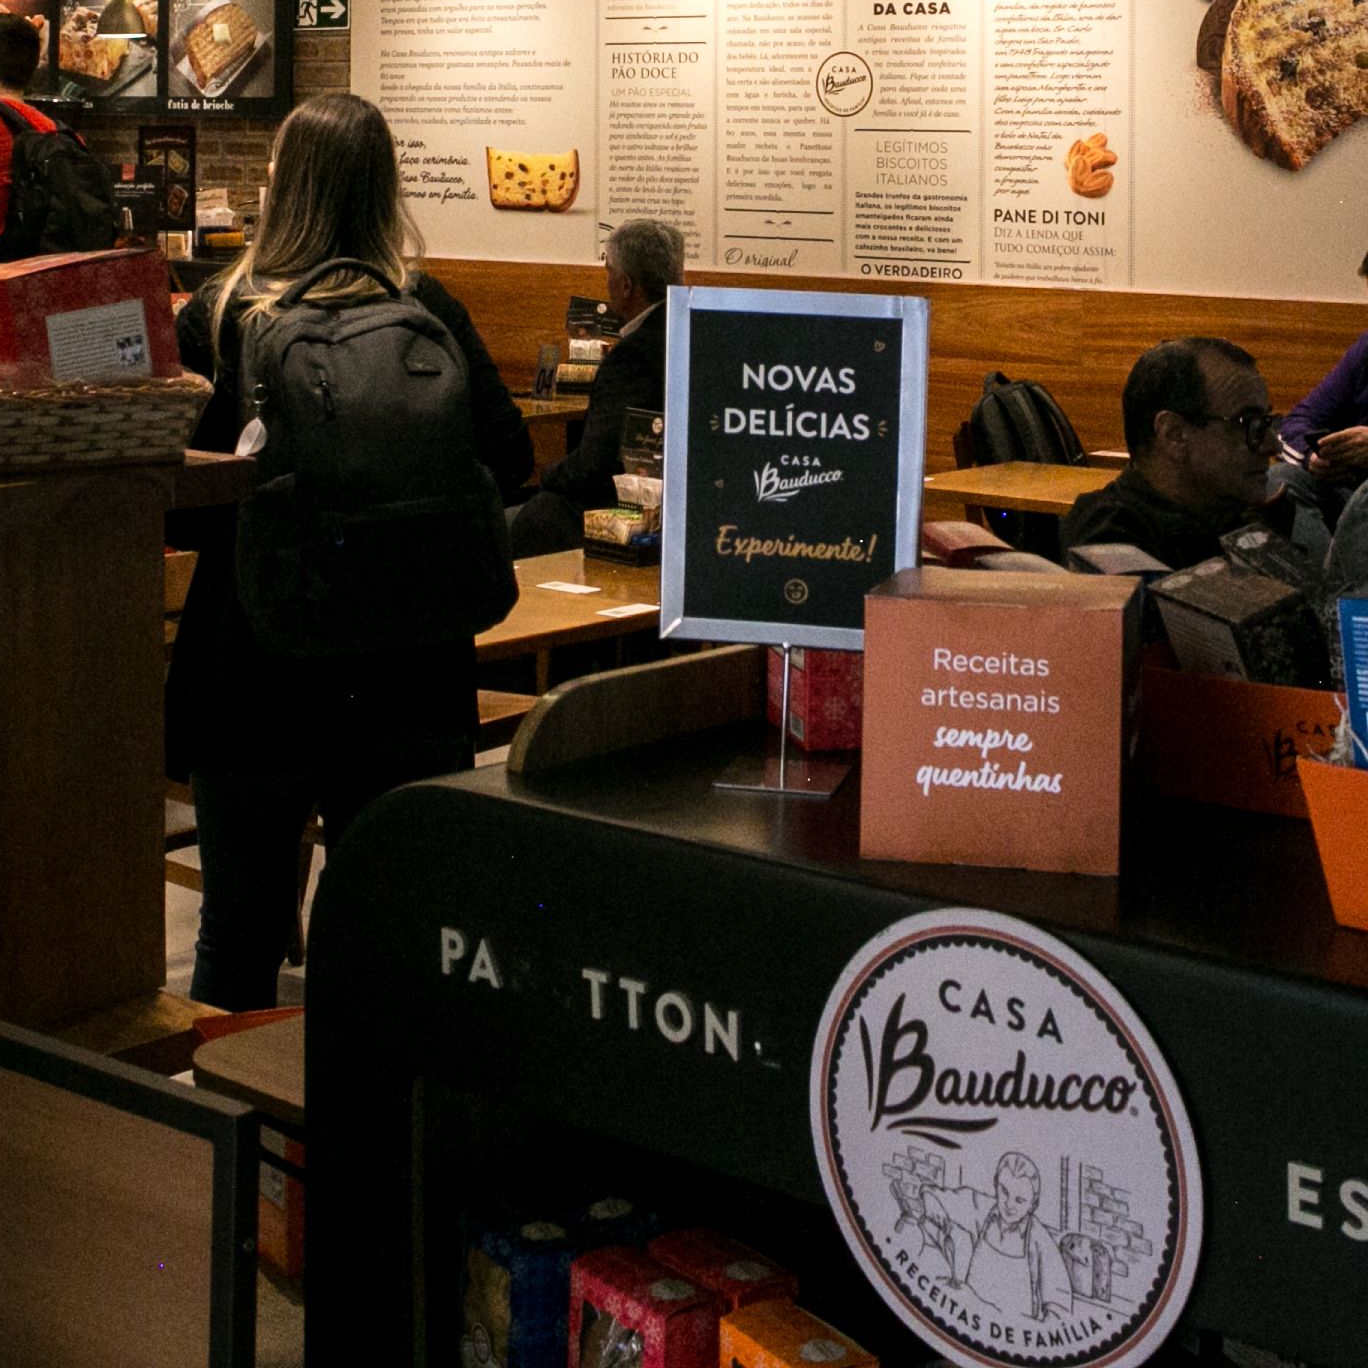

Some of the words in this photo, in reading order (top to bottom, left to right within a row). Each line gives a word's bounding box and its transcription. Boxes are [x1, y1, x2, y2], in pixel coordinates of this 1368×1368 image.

[873, 3, 897, 15] DA
[903, 2, 951, 15] CASA
[611, 49, 674, 64] HISTÓRIA
[678, 52, 699, 64] DO
[612, 65, 636, 79] PÃO
[641, 67, 677, 79] DOCE
[612, 88, 626, 97] UM
[628, 86, 647, 97] PÃO
[649, 88, 693, 97] ESPECIAL
[167, 99, 188, 111] fatia
[190, 101, 200, 110] de
[203, 100, 235, 112] brioche
[876, 139, 948, 154] LEGÍTIMOS
[876, 157, 948, 170] BISCOITOS
[876, 173, 948, 186] ITALIANOS
[923, 194, 968, 202] gastronomia
[993, 208, 1037, 224] PANE
[1042, 210, 1059, 224] DI
[1064, 211, 1105, 226] TONI
[1016, 228, 1023, 238] A
[1026, 229, 1060, 240] LENDA
[1062, 230, 1084, 242] QUE
[724, 247, 743, 265] O
[744, 248, 799, 269] original
[993, 242, 1023, 253] TUDO
[1026, 244, 1080, 257] COMEÇOU
[1082, 246, 1117, 256] ASSIM:
[860, 263, 872, 275] O
[875, 264, 963, 280] VERDADEIRO
[742, 363, 856, 396] NOVAS
[723, 404, 871, 441] DELÍCIAS
[780, 454, 822, 468] CASA
[754, 461, 844, 502] Bauducco
[715, 525, 879, 566] Experimente!
[933, 648, 1050, 677] Receitas
[921, 685, 1061, 714] artesanais
[934, 725, 1033, 758] sempre
[915, 762, 1063, 797] quentinhas
[938, 979, 1063, 1044] CASA
[859, 992, 1137, 1133] Bauducco
[895, 1249, 983, 1331] RECEITAS
[990, 1321, 1017, 1345] DE
[1023, 1317, 1104, 1349] FAMÍLIA
